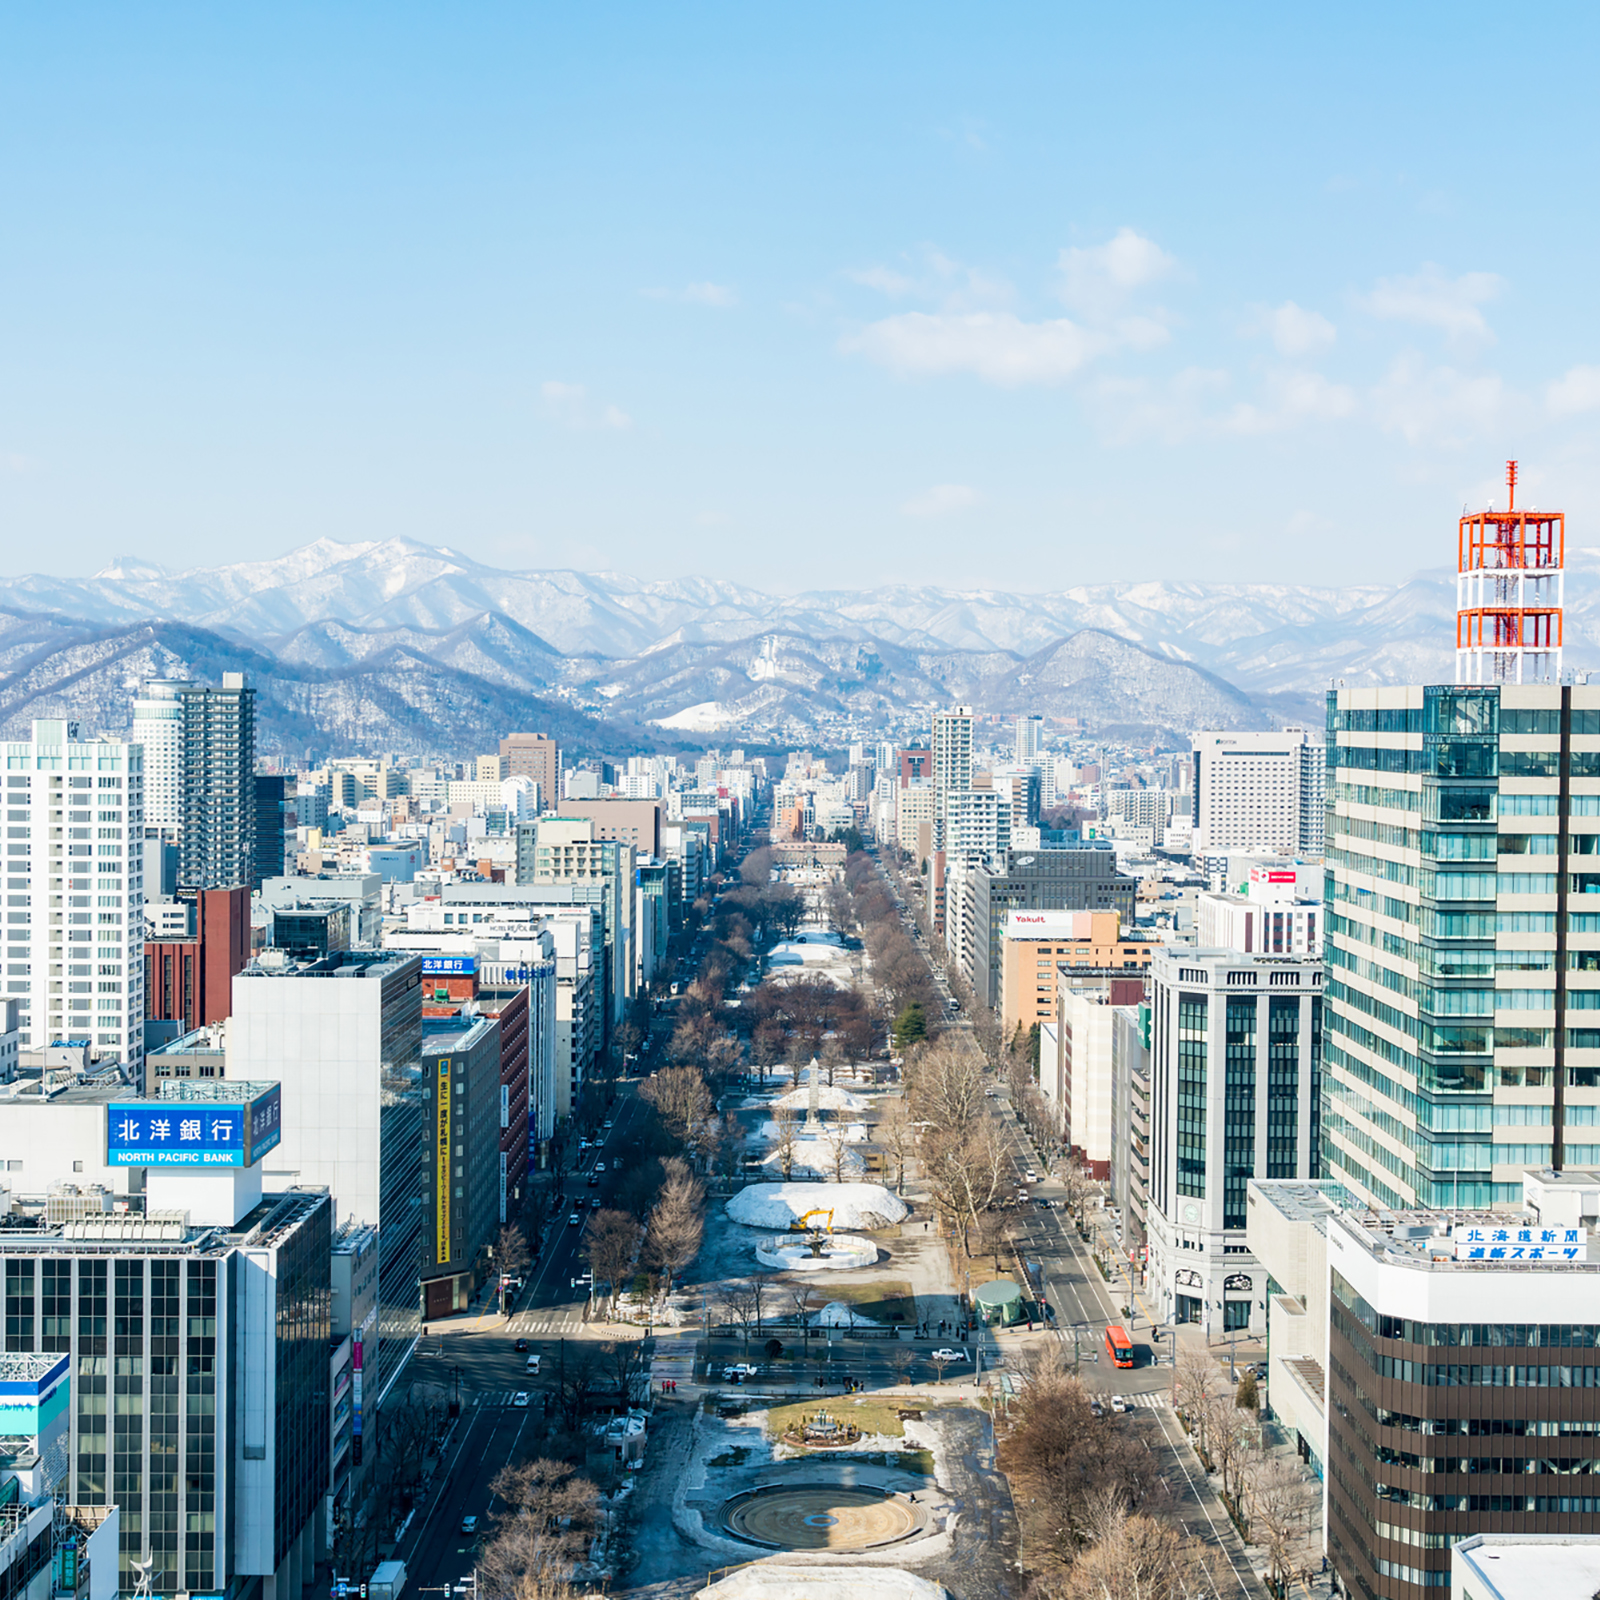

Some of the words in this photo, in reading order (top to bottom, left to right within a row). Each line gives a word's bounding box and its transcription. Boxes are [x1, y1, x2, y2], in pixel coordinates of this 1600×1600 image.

[423, 959, 463, 970] 北洋銀行
[118, 1119, 233, 1141] 北洋銀行
[118, 1153, 154, 1162] NORTH
[158, 1153, 199, 1162] PACIFIC
[203, 1153, 233, 1162] BANK
[1467, 1230, 1578, 1242] 北海道新聞
[1468, 1246, 1579, 1259] 道新スポーツ
